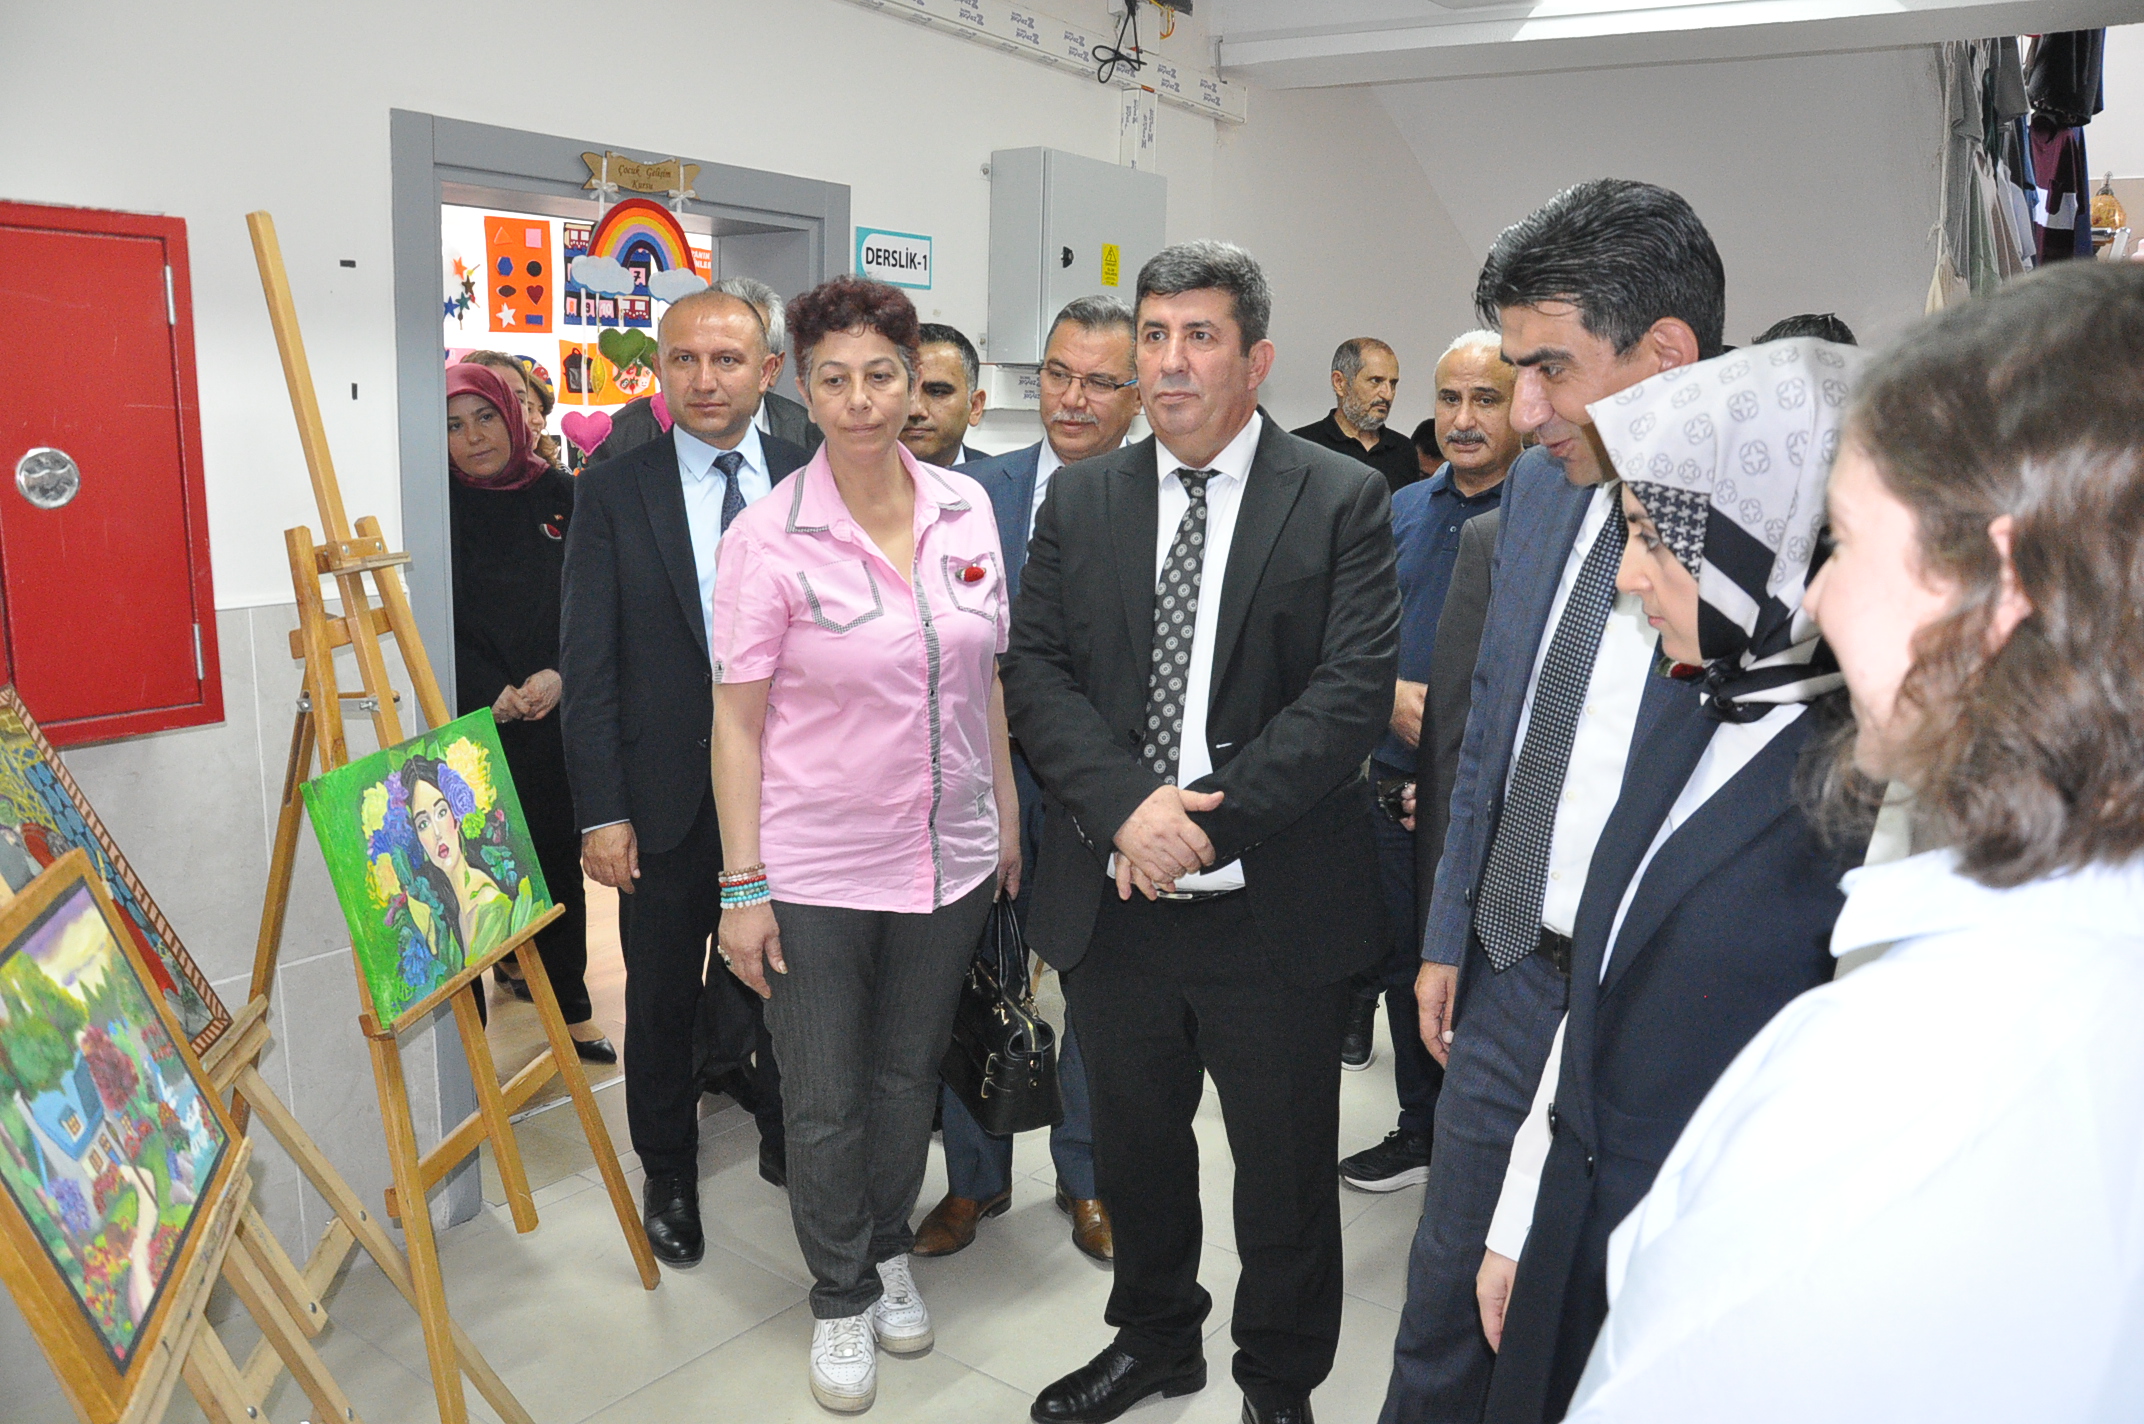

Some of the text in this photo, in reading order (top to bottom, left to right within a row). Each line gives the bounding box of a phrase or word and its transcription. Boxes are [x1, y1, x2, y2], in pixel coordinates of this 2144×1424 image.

[618, 164, 671, 179] Çocuk Gelişim
[631, 179, 653, 190] Kursu
[865, 246, 928, 271] DERSLİK-1
[633, 271, 641, 281] 7
[569, 300, 575, 312] 8
[585, 302, 591, 313] 9
[601, 303, 613, 314] 10
